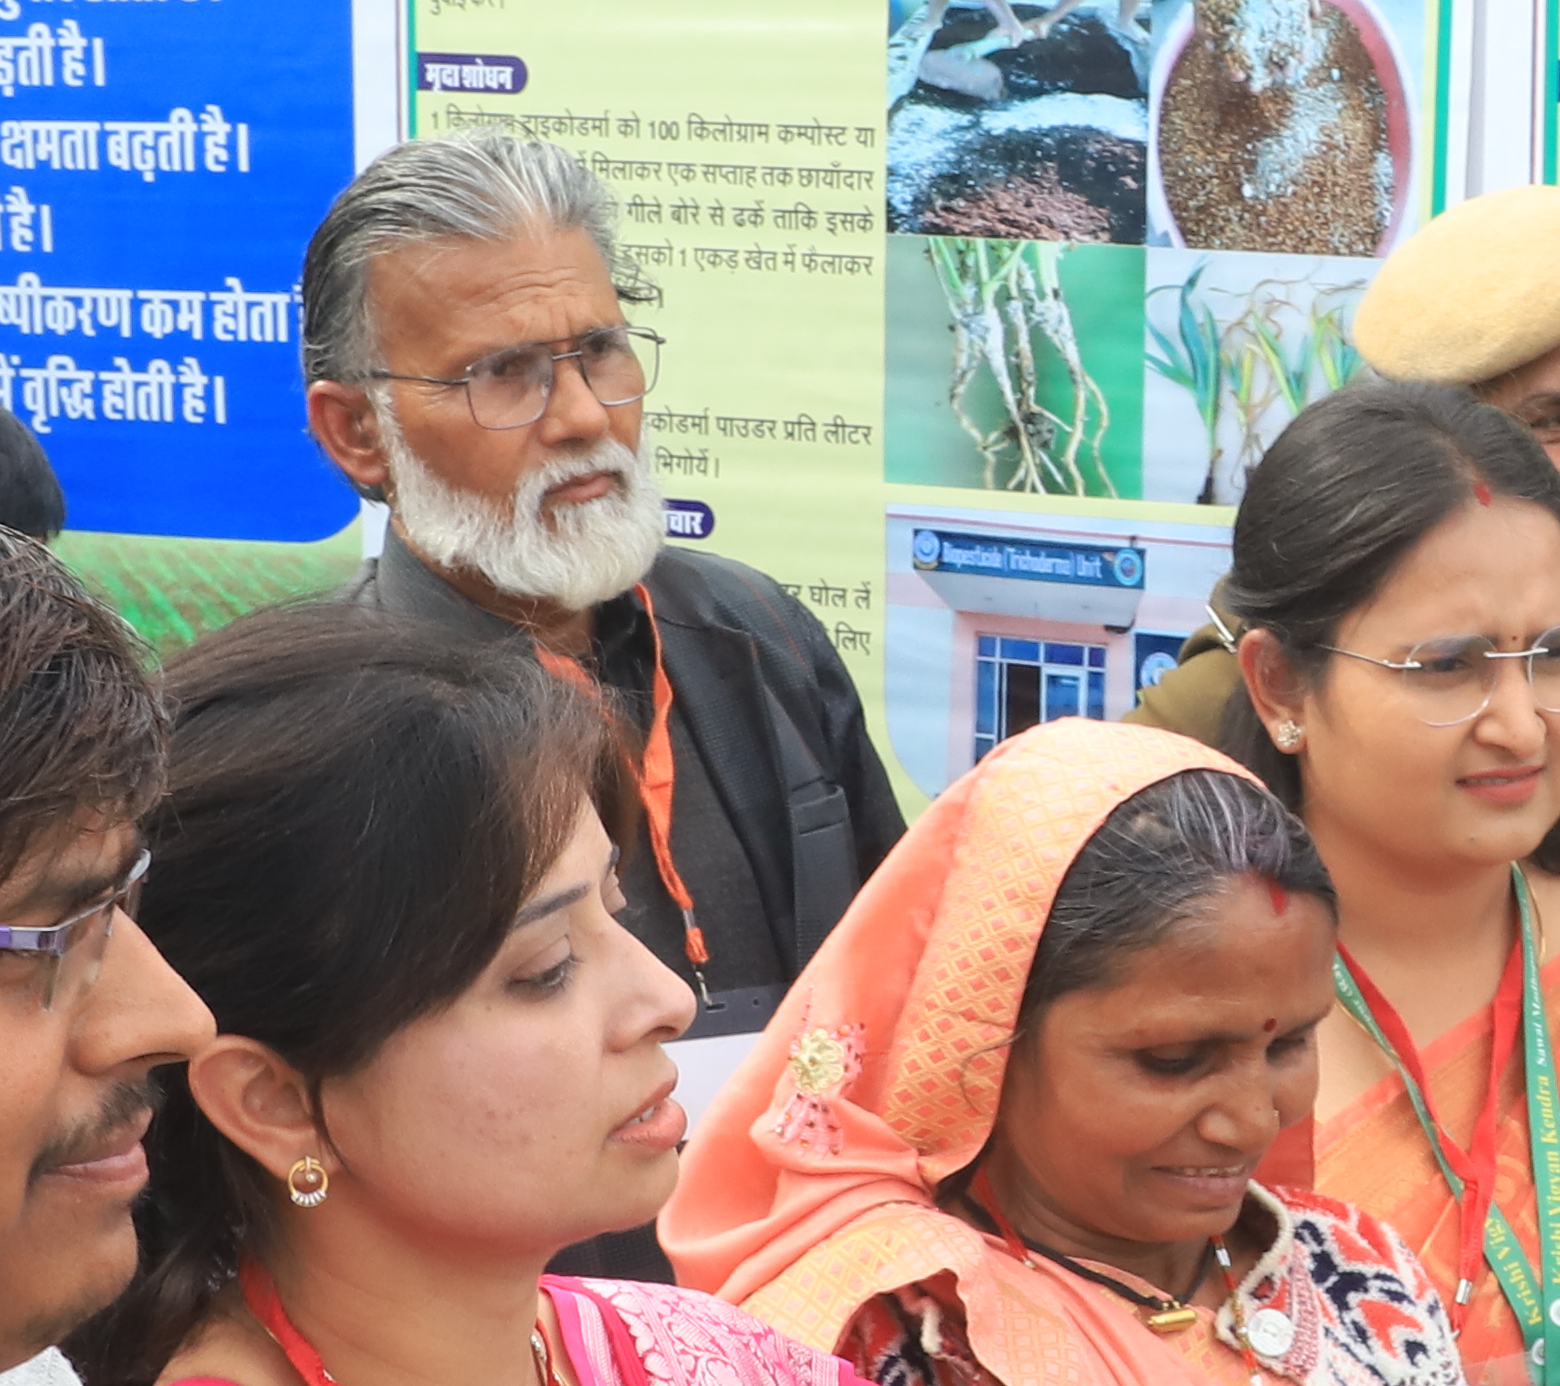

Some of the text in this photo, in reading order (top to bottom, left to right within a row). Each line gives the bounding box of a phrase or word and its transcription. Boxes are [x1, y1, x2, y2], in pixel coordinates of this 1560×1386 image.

[55, 18, 106, 87] है।
[0, 120, 102, 171] क्षमता
[102, 107, 199, 183] बढ़ती
[199, 104, 250, 173] है।
[4, 185, 53, 253] है।
[136, 289, 207, 340] कम
[208, 276, 291, 343] होता
[24, 354, 99, 437] वृद्धि
[98, 356, 177, 422] होती
[177, 356, 226, 424] है।
[1536, 1075, 1558, 1144] Kendra
[1509, 1260, 1542, 1326] Krishi
